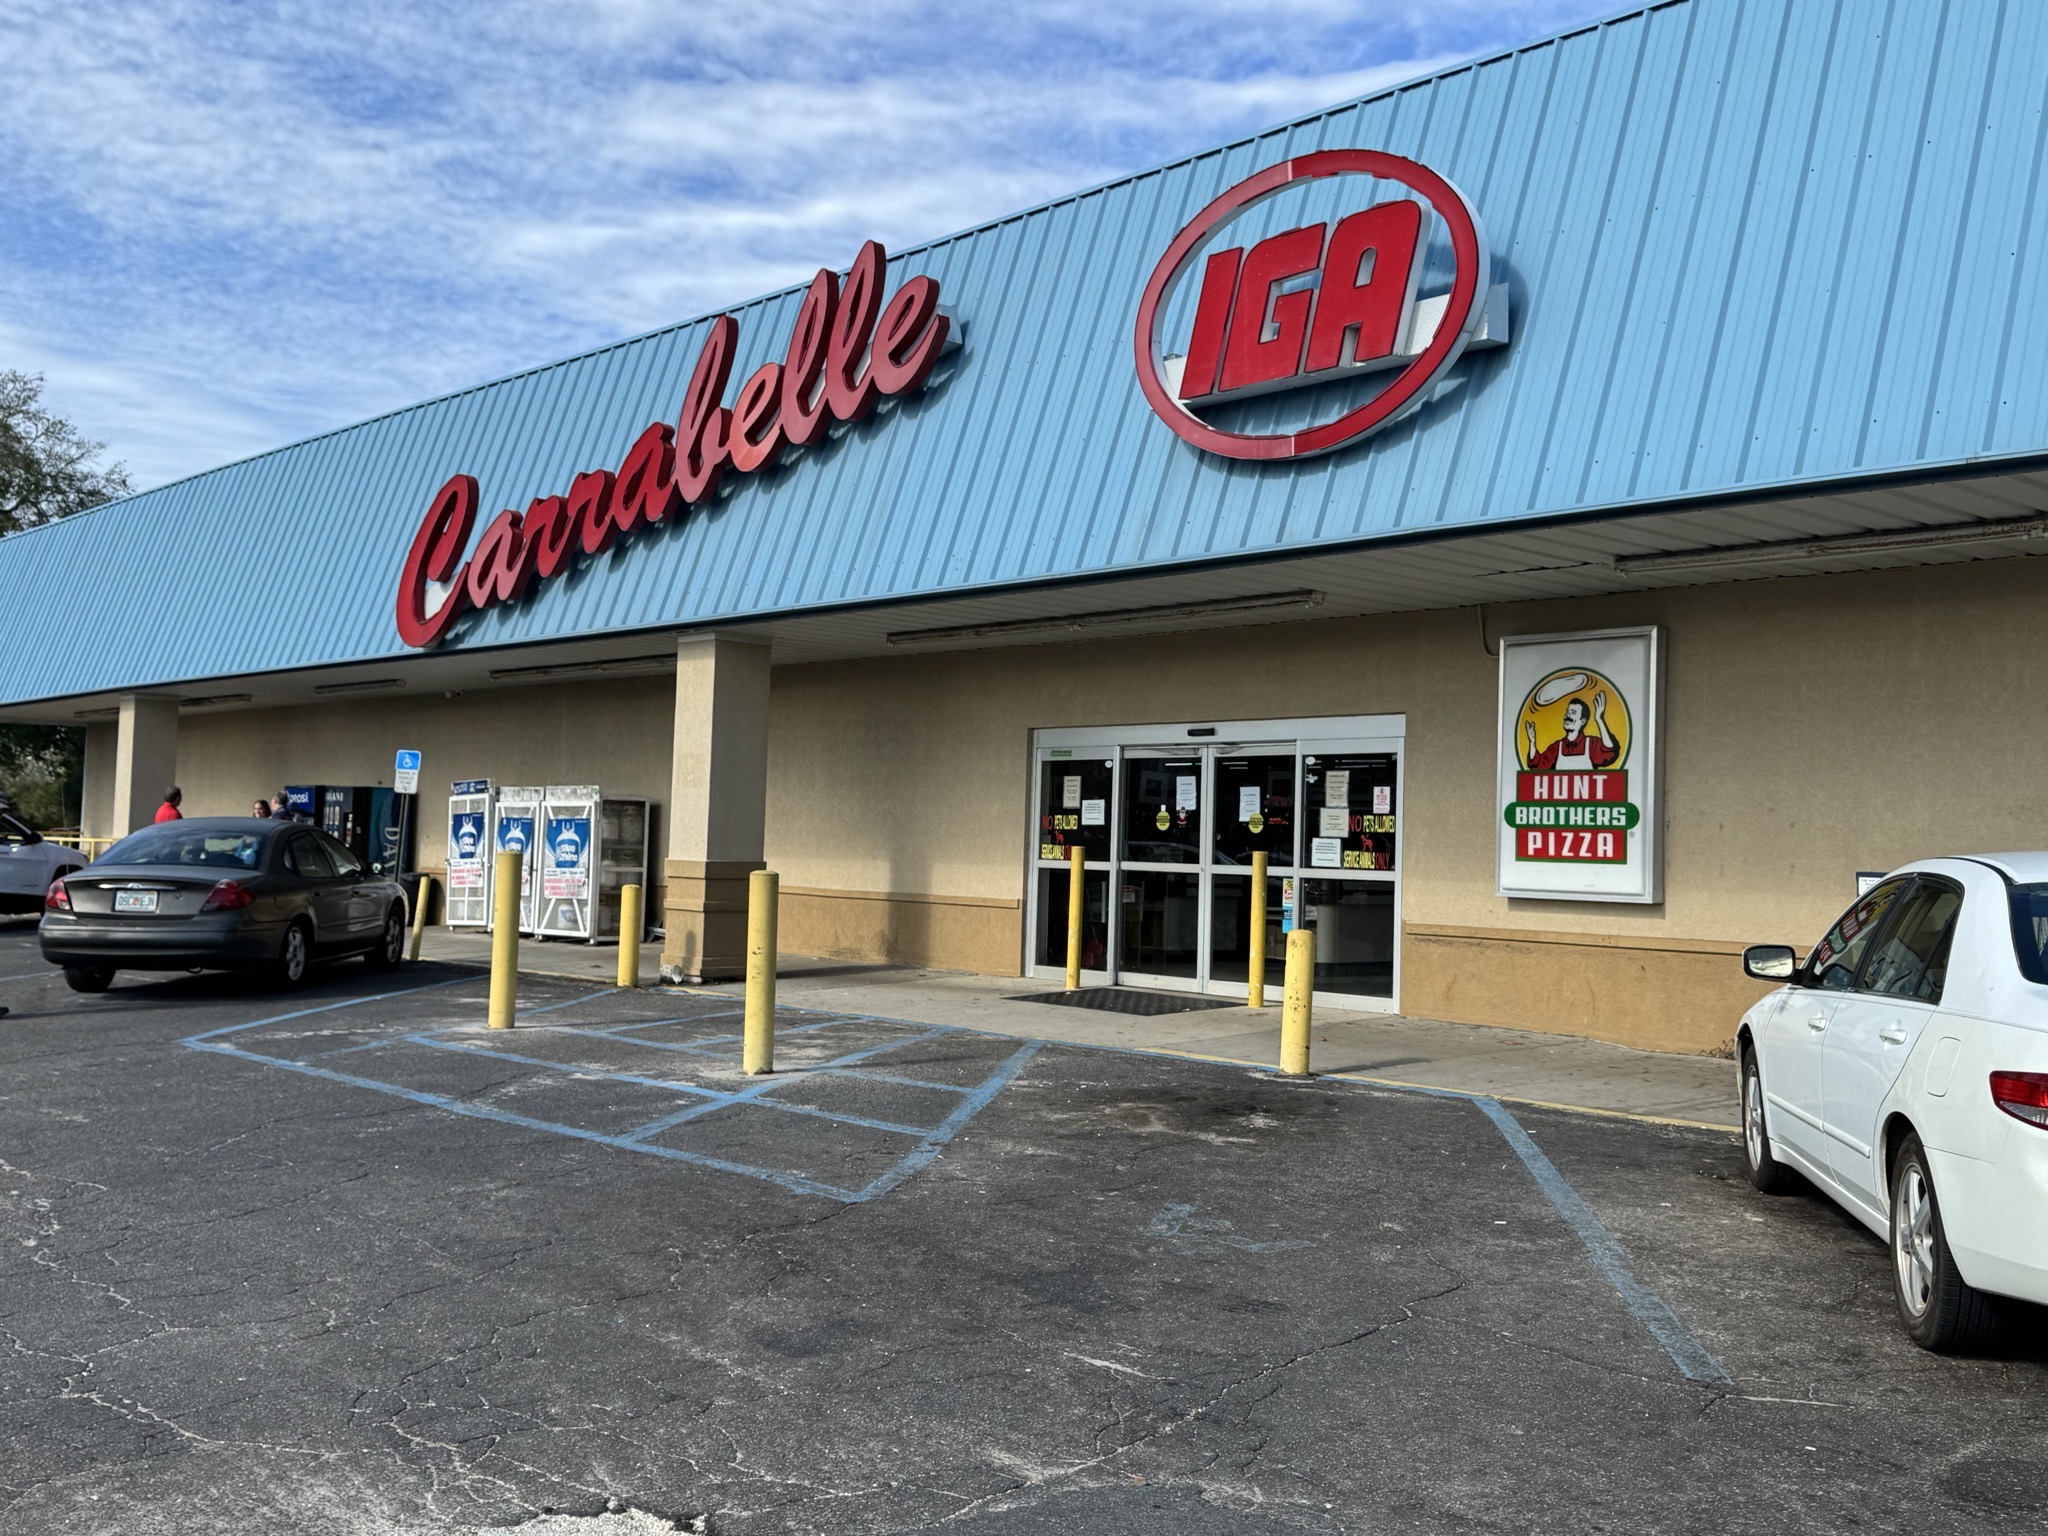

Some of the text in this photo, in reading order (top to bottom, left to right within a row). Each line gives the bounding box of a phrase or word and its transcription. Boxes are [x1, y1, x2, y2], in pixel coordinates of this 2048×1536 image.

[1178, 199, 1430, 401] IGA
[396, 239, 950, 648] Carrabelle
[1533, 775, 1607, 800] HUNT
[1348, 814, 1362, 832] NO
[1363, 815, 1374, 833] PETS
[1375, 815, 1395, 833] ALLOWED
[1515, 806, 1627, 826] BROTHERS
[1527, 831, 1614, 858] PIZZA
[1343, 850, 1360, 868] SERVICE
[1360, 851, 1376, 869] ANIMALS
[1376, 852, 1390, 869] ONLY
